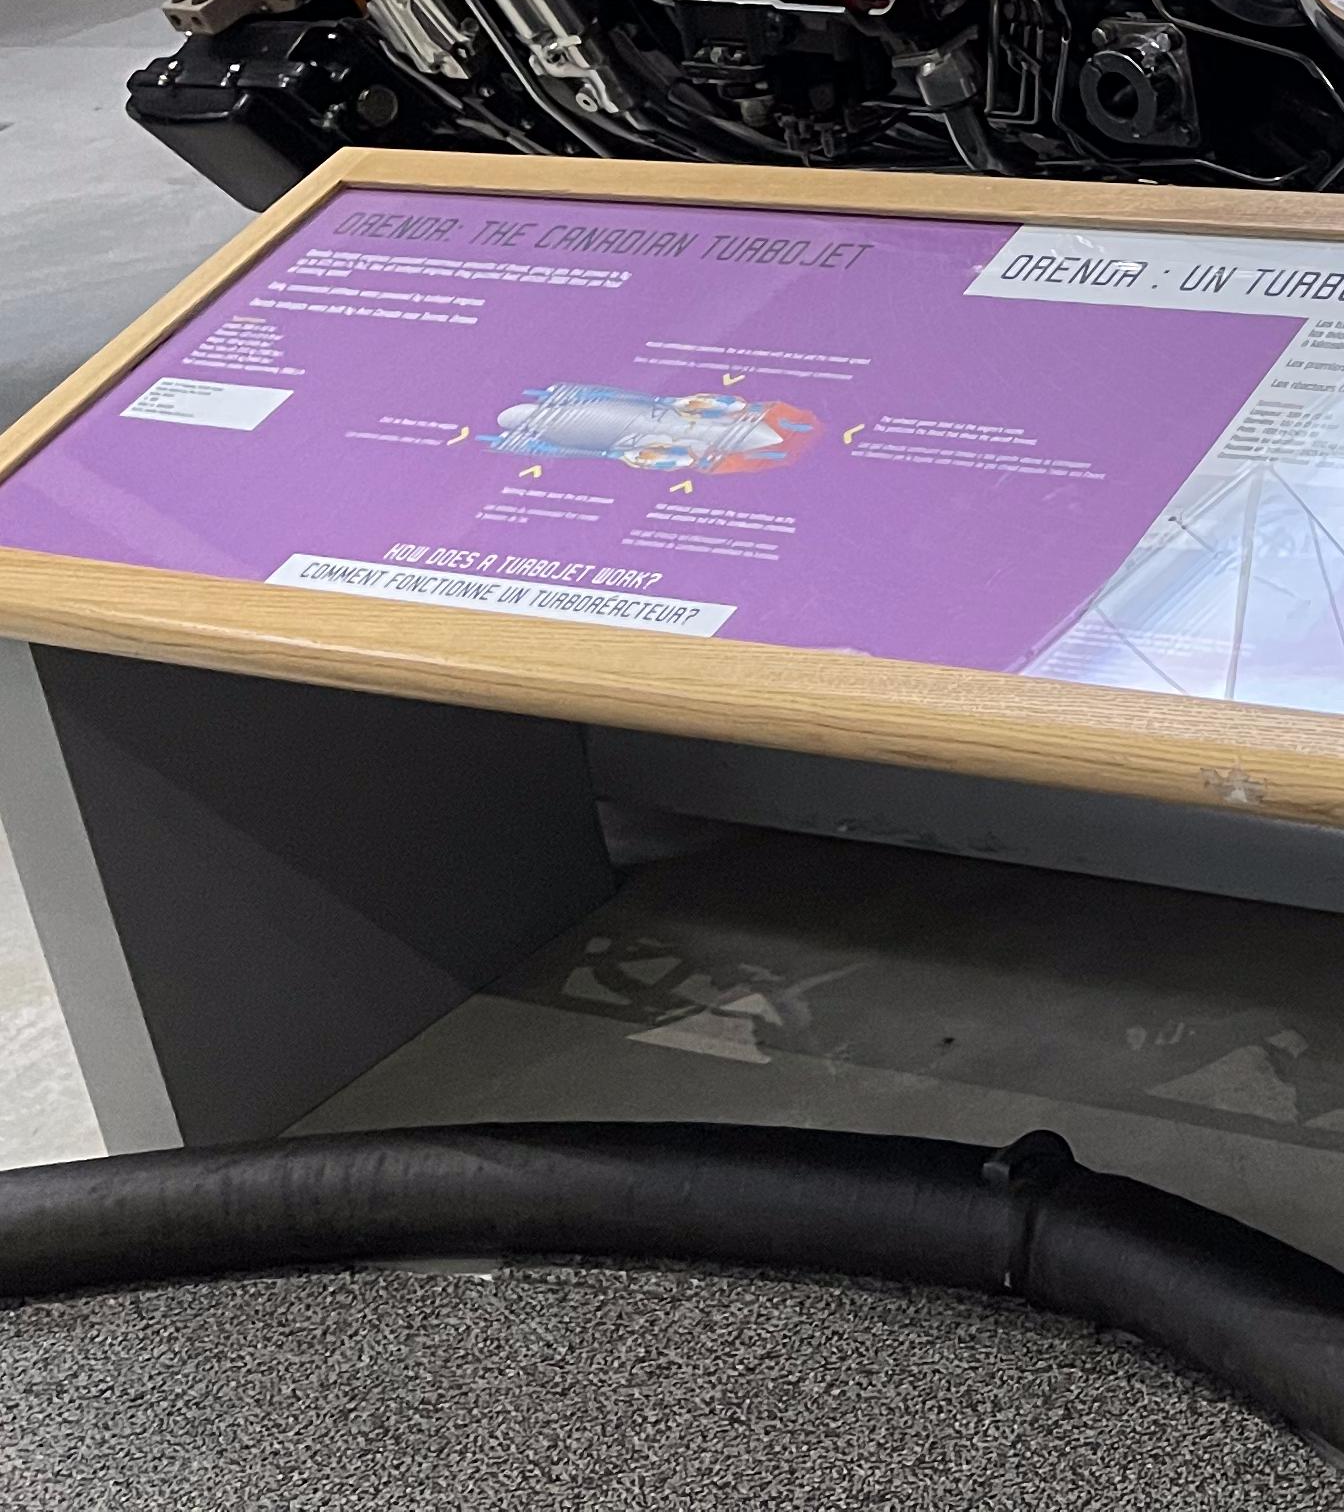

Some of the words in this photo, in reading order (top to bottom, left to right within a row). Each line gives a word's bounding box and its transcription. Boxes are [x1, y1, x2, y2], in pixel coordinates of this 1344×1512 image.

[332, 211, 464, 242] ORENDA:
[468, 219, 538, 247] THE
[534, 224, 699, 257] CANADIAN
[700, 234, 874, 269] TURBOJET
[1000, 254, 1149, 288] ORENDA
[1178, 264, 1238, 293] UN
[384, 543, 431, 563] HOW
[425, 548, 481, 569] DOES
[476, 554, 498, 572] A
[496, 555, 596, 583] TURBOJET
[591, 567, 663, 590] WORK?
[299, 562, 390, 588] COMMENT
[384, 572, 501, 601] FONCTIONNE
[497, 582, 530, 604] UN
[528, 590, 701, 626] TURBORÉACTEUR?
